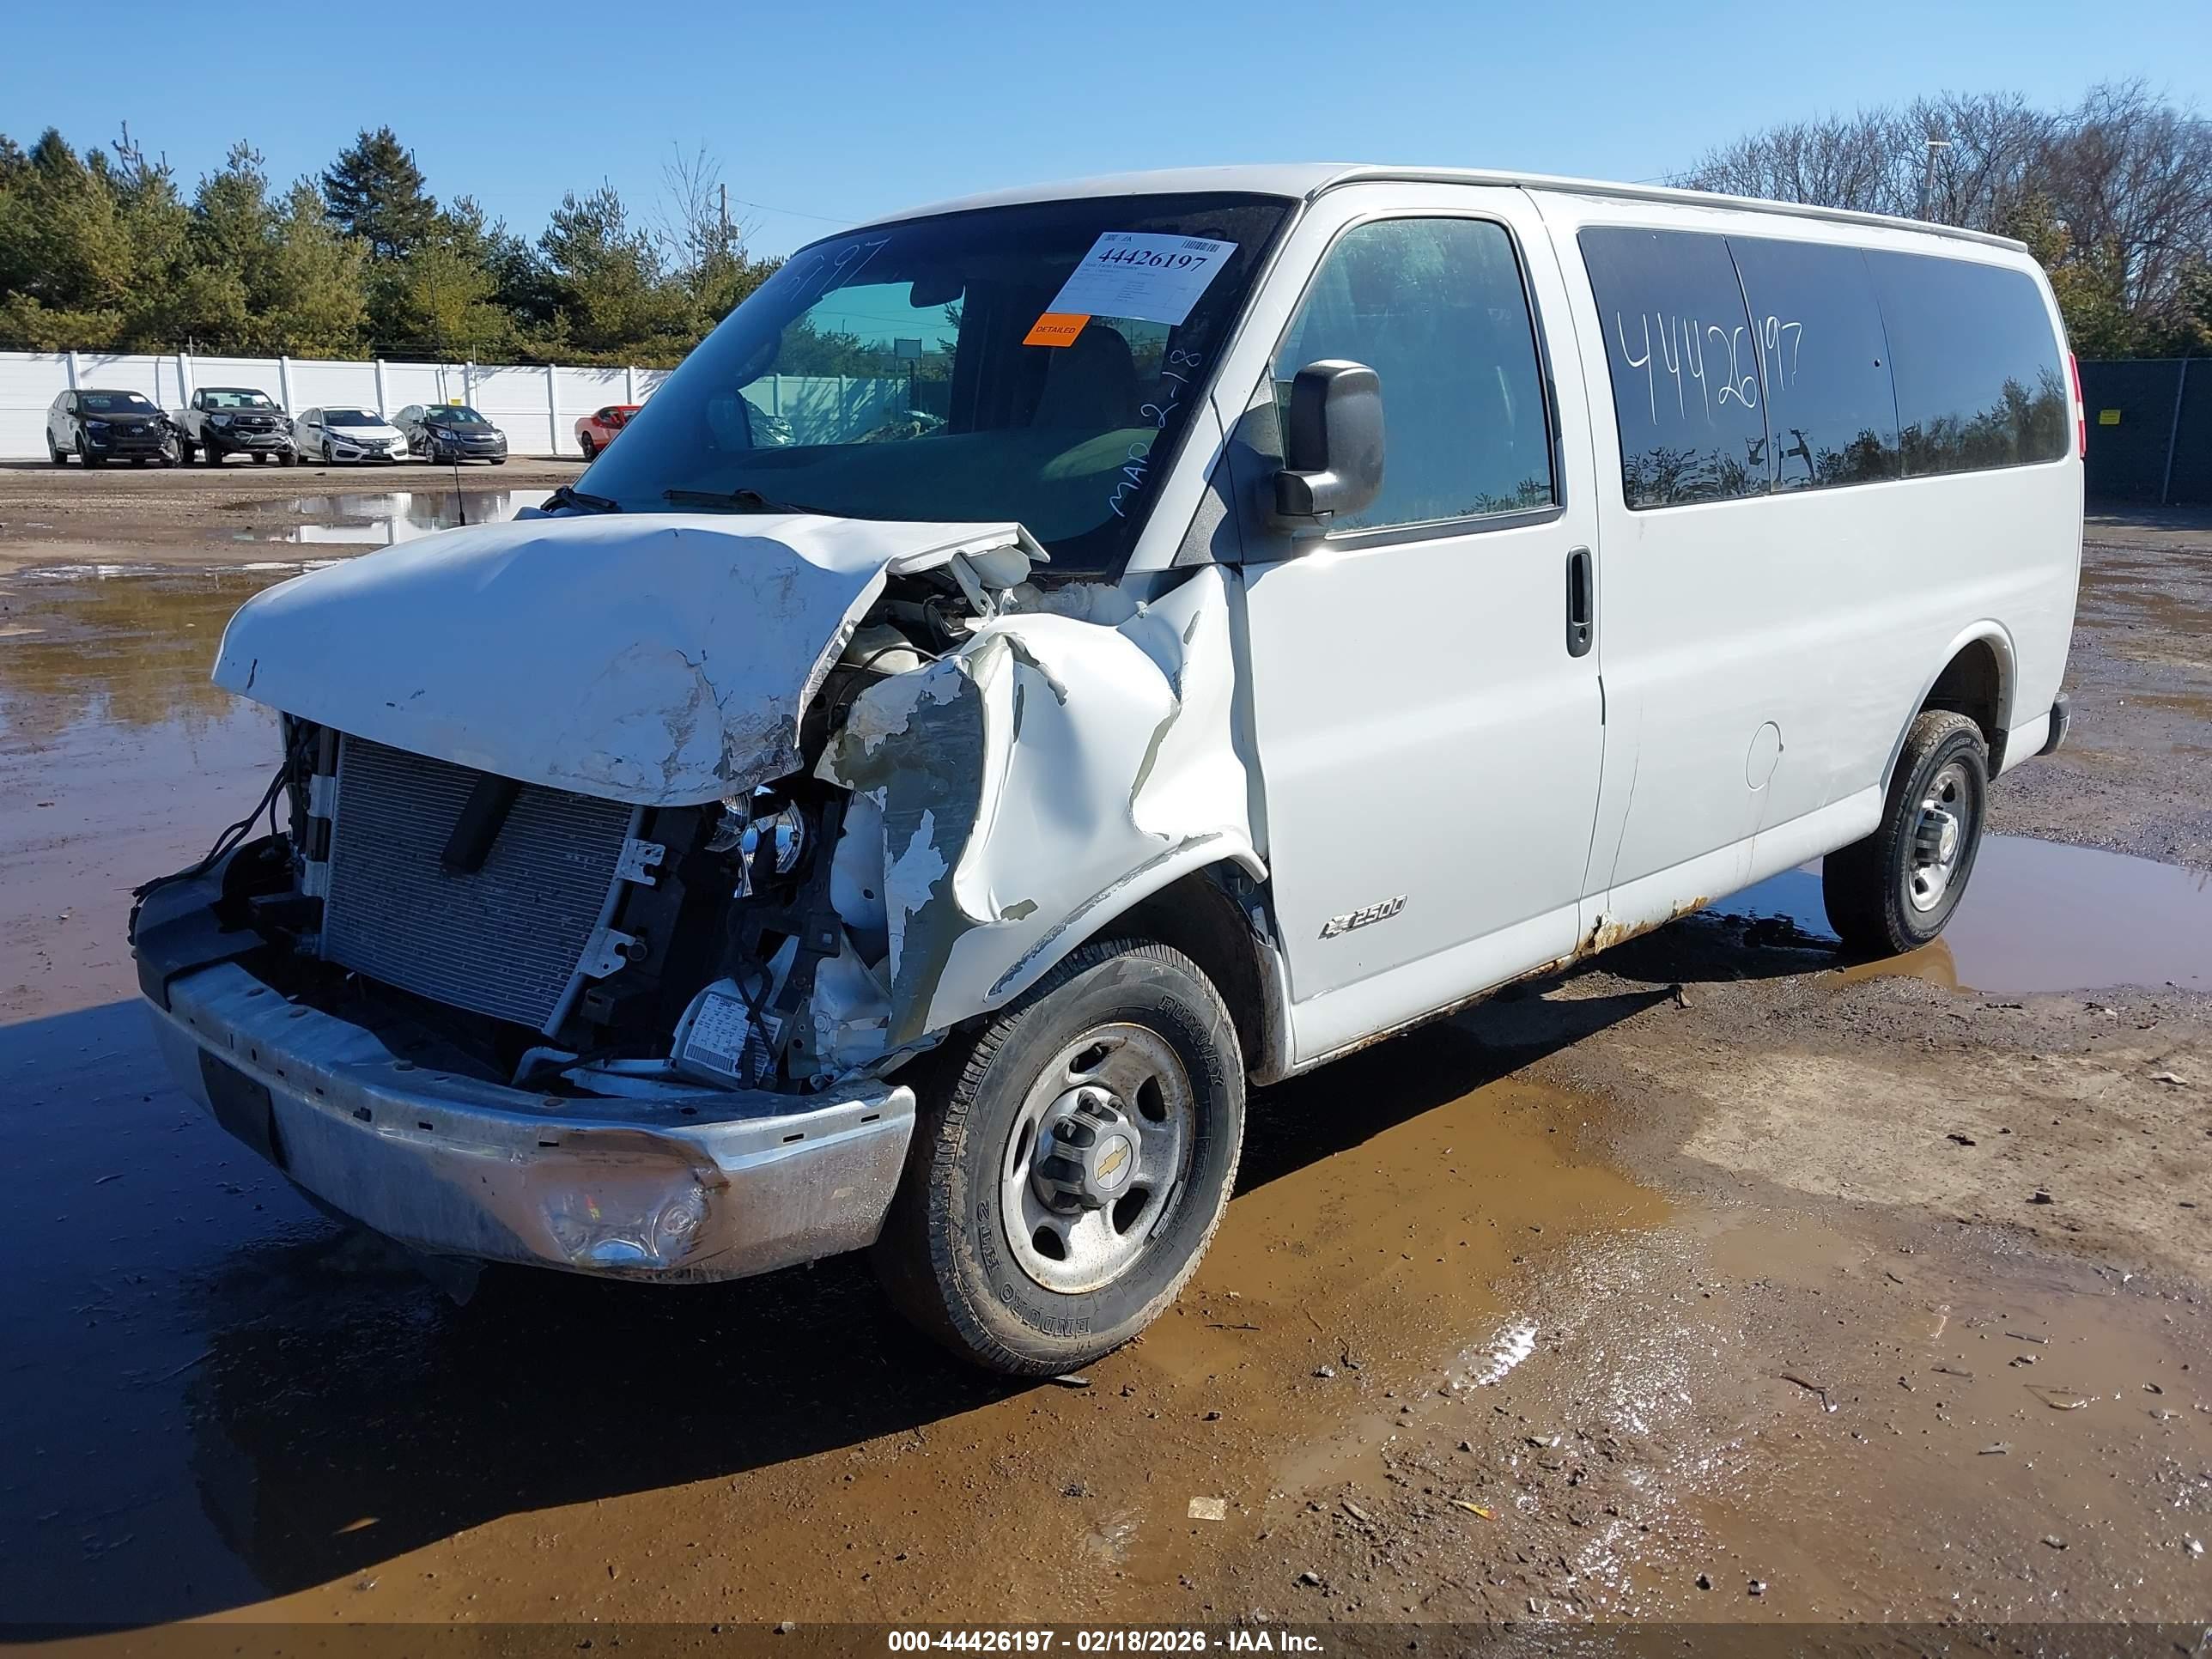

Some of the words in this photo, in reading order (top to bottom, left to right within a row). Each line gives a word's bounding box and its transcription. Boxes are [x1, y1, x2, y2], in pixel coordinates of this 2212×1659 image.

[1098, 247, 1208, 272] 44426197
[1036, 325, 1077, 335] DETAILED
[1140, 347, 1202, 429] 2-18
[1616, 310, 1803, 427] 44426197
[1352, 894, 1408, 928] 2500
[1156, 994, 1226, 1087] RUNWAY
[1000, 1282, 1092, 1338] ENDURO
